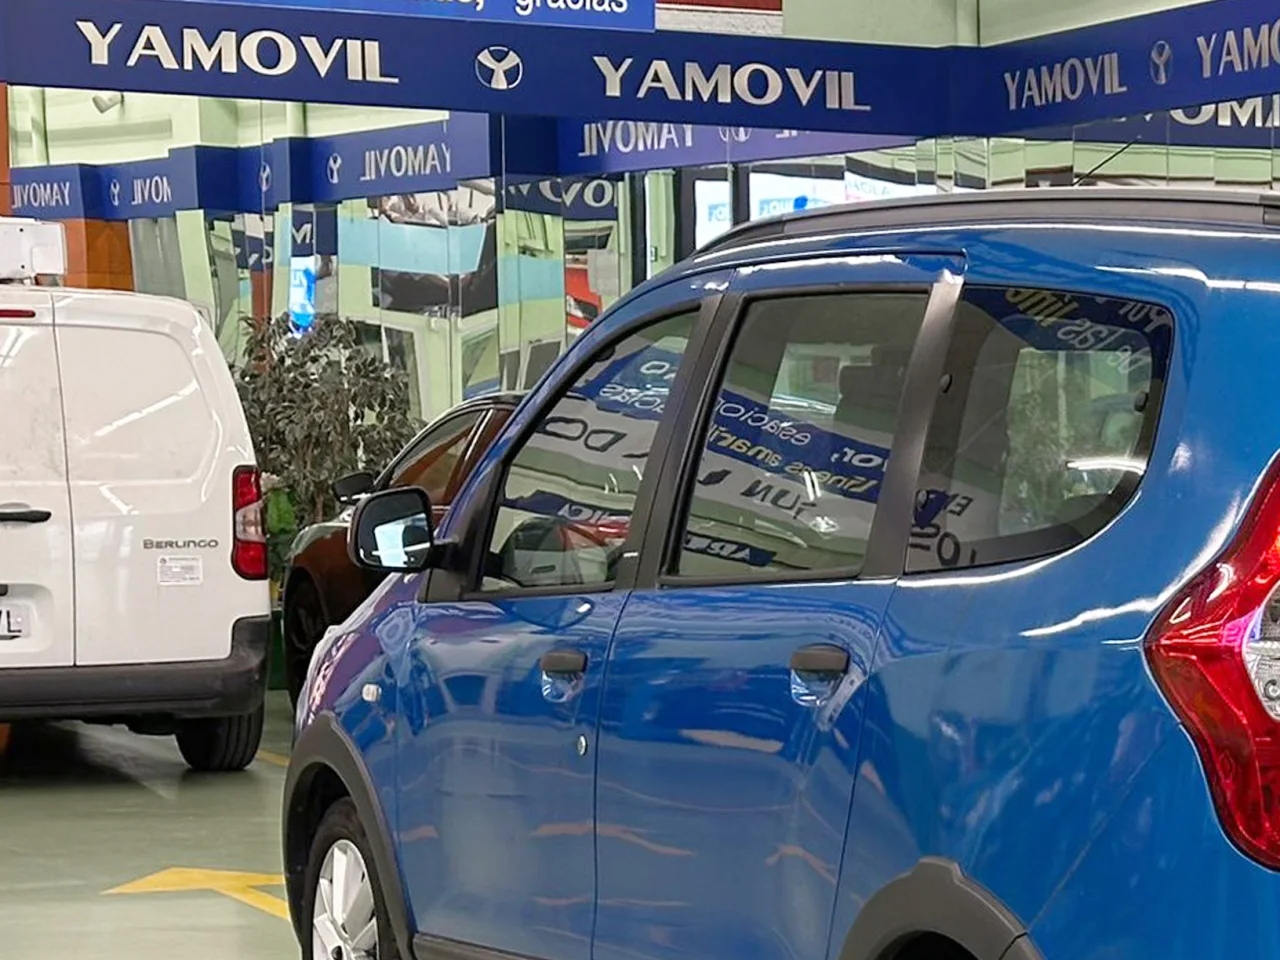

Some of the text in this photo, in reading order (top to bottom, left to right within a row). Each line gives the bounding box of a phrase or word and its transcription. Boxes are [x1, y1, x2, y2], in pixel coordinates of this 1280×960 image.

[75, 20, 400, 84] YAMOVIL
[593, 55, 872, 112] YAMOVIL
[1003, 52, 1128, 110] YAMOVIL
[143, 538, 219, 550] BERLINGO
